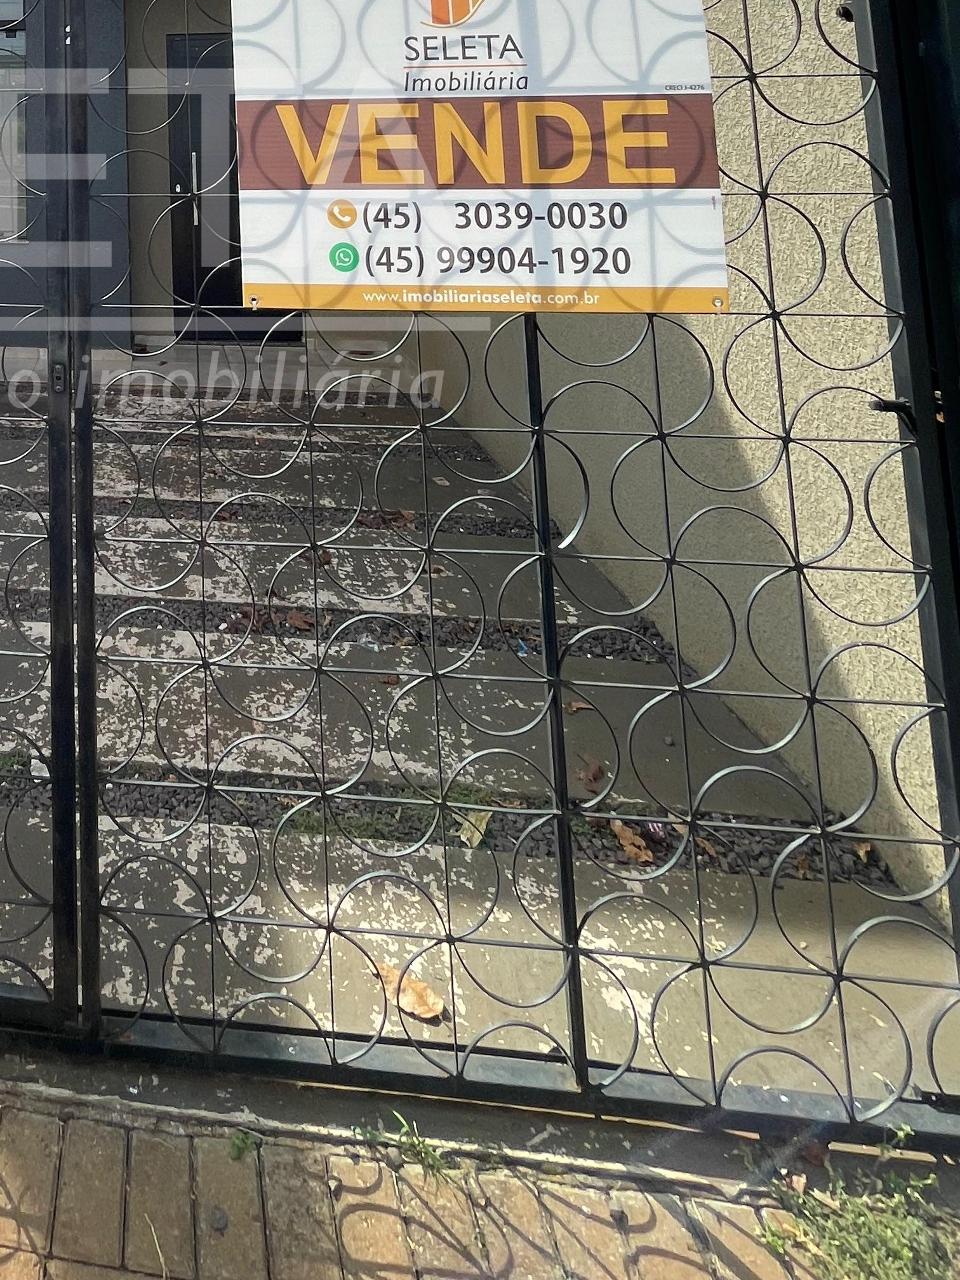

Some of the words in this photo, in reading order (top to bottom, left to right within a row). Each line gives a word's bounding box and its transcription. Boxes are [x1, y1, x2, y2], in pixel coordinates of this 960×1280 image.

[404, 34, 524, 61] SELETA
[404, 70, 530, 93] Imobiliária
[275, 99, 676, 186] VENDE
[362, 202, 423, 234] (45)
[454, 201, 628, 231] 3039-0030
[365, 246, 425, 278] (45)
[436, 245, 632, 275] 99904-1920
[362, 289, 600, 306] www.imobiliariaseleta.com.br
